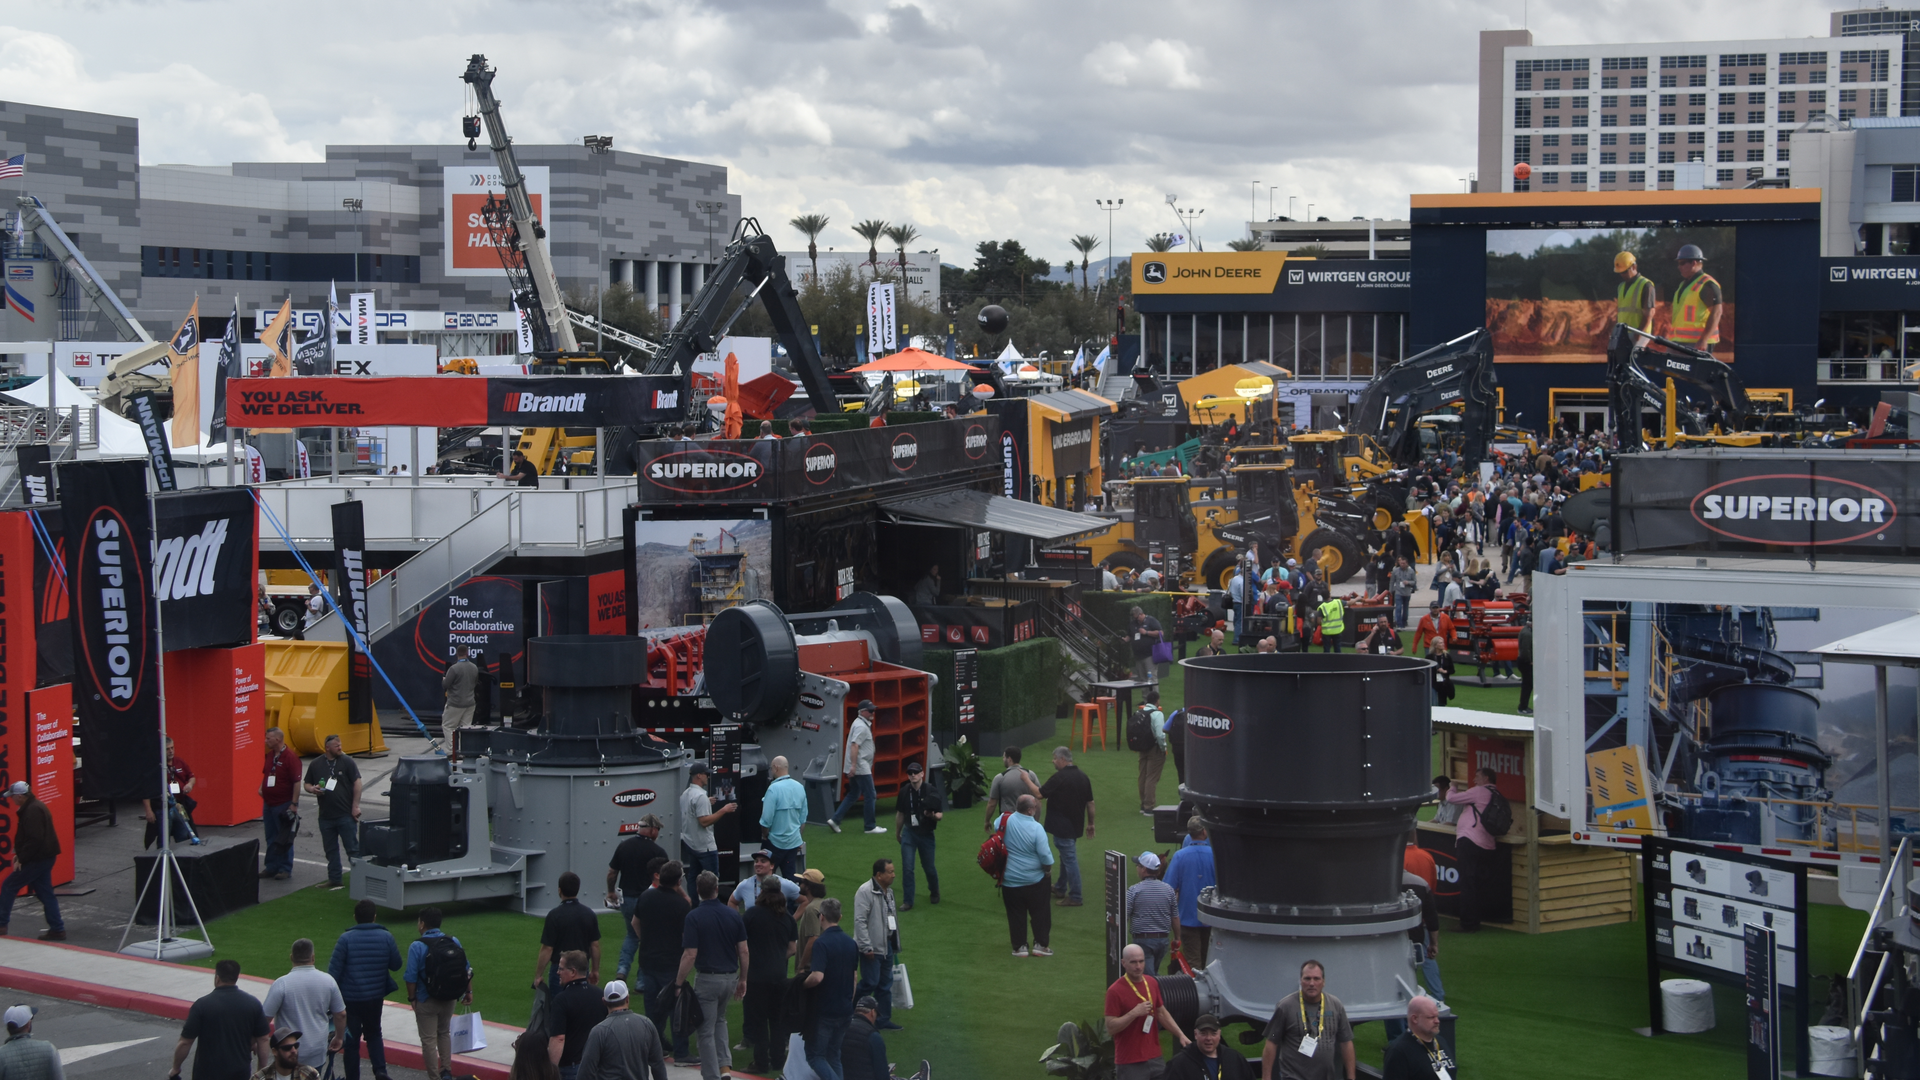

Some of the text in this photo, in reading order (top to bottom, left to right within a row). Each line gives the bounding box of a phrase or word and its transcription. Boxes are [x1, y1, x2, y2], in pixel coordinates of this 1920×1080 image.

[1172, 266, 1262, 279] JOHN DEERE
[1307, 270, 1366, 282] WIRTGEN
[1851, 268, 1917, 280] WIRTGEN
[459, 313, 498, 327] GENCOR
[1426, 363, 1454, 379] DEERE
[1665, 358, 1691, 372] DEERE
[241, 390, 328, 403] YOU ASK.
[656, 389, 679, 409] Brandt
[1440, 388, 1461, 401] DEERE
[1643, 391, 1662, 409] DEERE
[241, 403, 365, 415] WE DELIVER.
[517, 392, 587, 413] Brandt
[135, 395, 174, 490] IPPMANN
[965, 433, 987, 450] SUPERIOR
[891, 441, 917, 460] SUPERIOR
[805, 453, 836, 473] SUPERIOR
[651, 462, 757, 479] SUPERIOR
[1703, 494, 1885, 523] SUPERIOR
[1315, 518, 1337, 532] DEERE
[1222, 531, 1245, 543] DEERE
[449, 595, 468, 606] The
[597, 592, 614, 607] YOU
[95, 518, 133, 700] SUPERIOR
[449, 608, 494, 619] Power of
[597, 607, 611, 621] WE
[449, 620, 514, 632] Collaborative
[449, 633, 489, 644] Product
[235, 667, 243, 676] The
[235, 674, 252, 686] Power of
[235, 682, 259, 695] Collaborative
[235, 694, 250, 704] Product
[800, 695, 824, 707] SUPERIOR
[235, 704, 248, 715] Design
[36, 712, 47, 721] The
[1186, 712, 1230, 731] SUPERIOR
[36, 719, 59, 733] Power of
[36, 728, 68, 743] Collaborative
[37, 742, 57, 754] Product
[37, 754, 55, 766] Design
[1475, 750, 1521, 776] TRAFFIC
[614, 792, 656, 804] SUPERIOR
